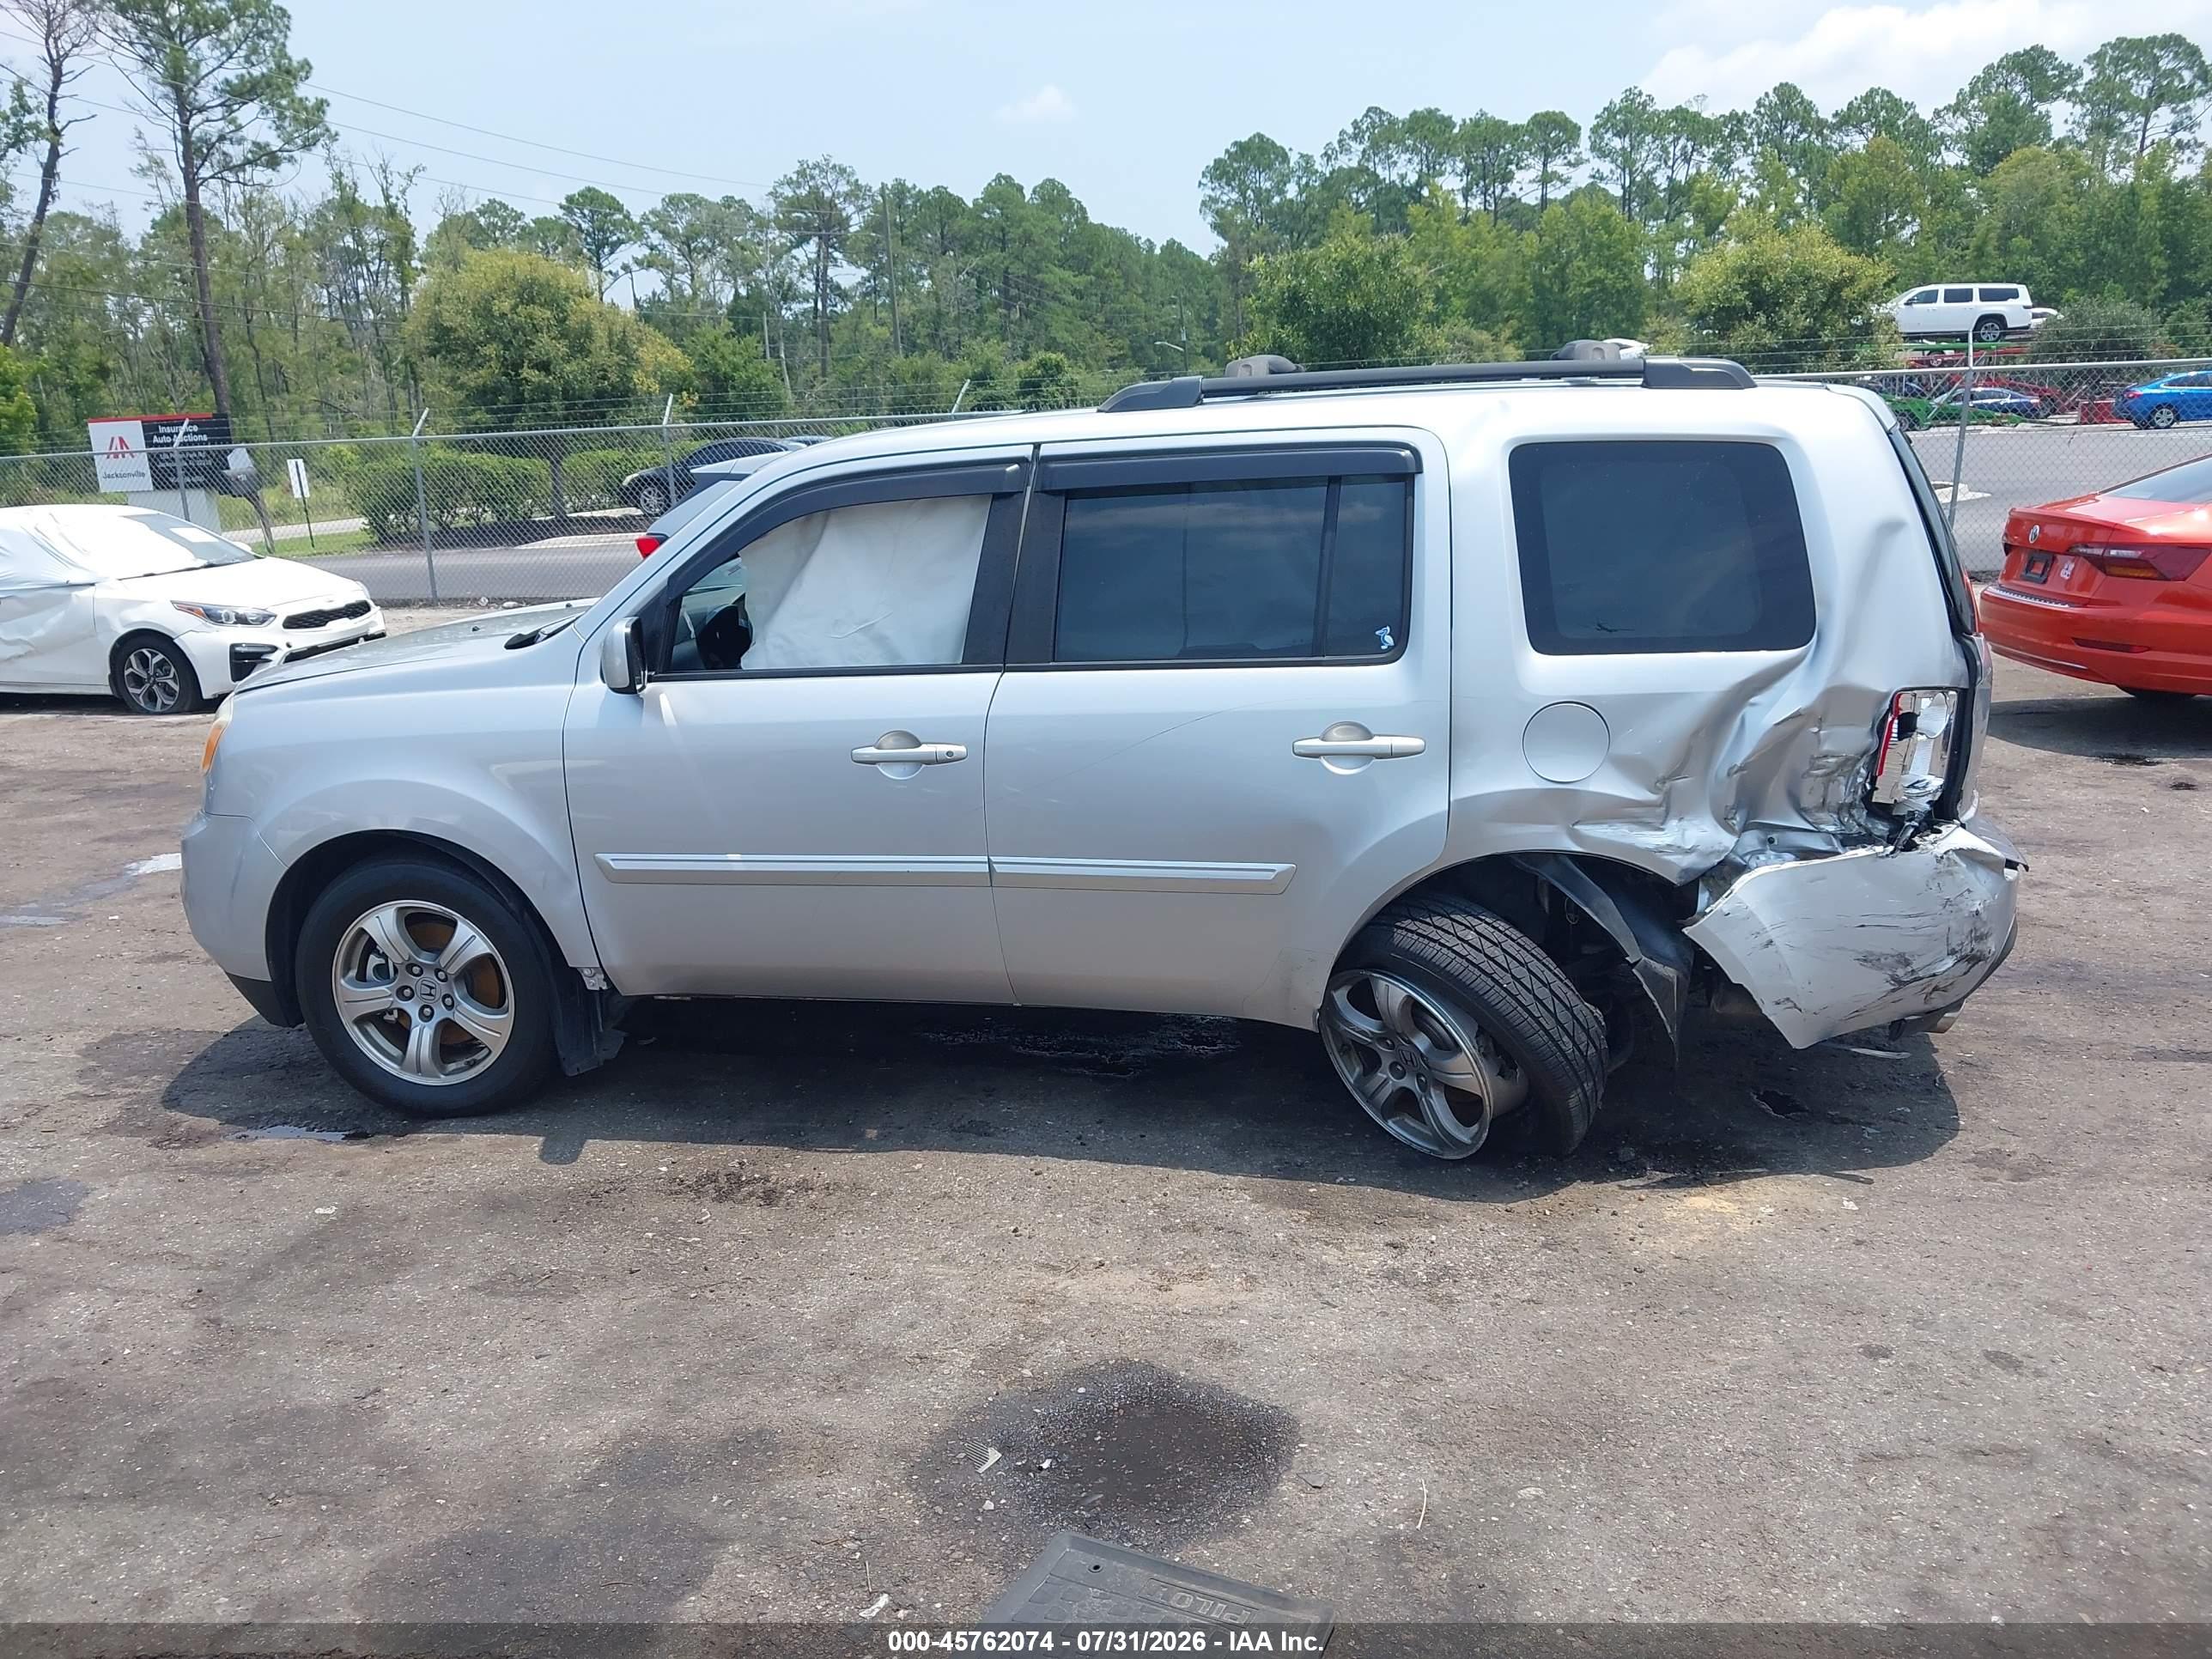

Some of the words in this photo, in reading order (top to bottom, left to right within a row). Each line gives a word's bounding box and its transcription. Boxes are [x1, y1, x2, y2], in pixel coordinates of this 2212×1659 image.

[158, 424, 198, 434] Insurnce
[153, 434, 172, 444] Auto
[102, 471, 146, 480] Jacksonville
[1144, 1583, 1251, 1626] PILOT
